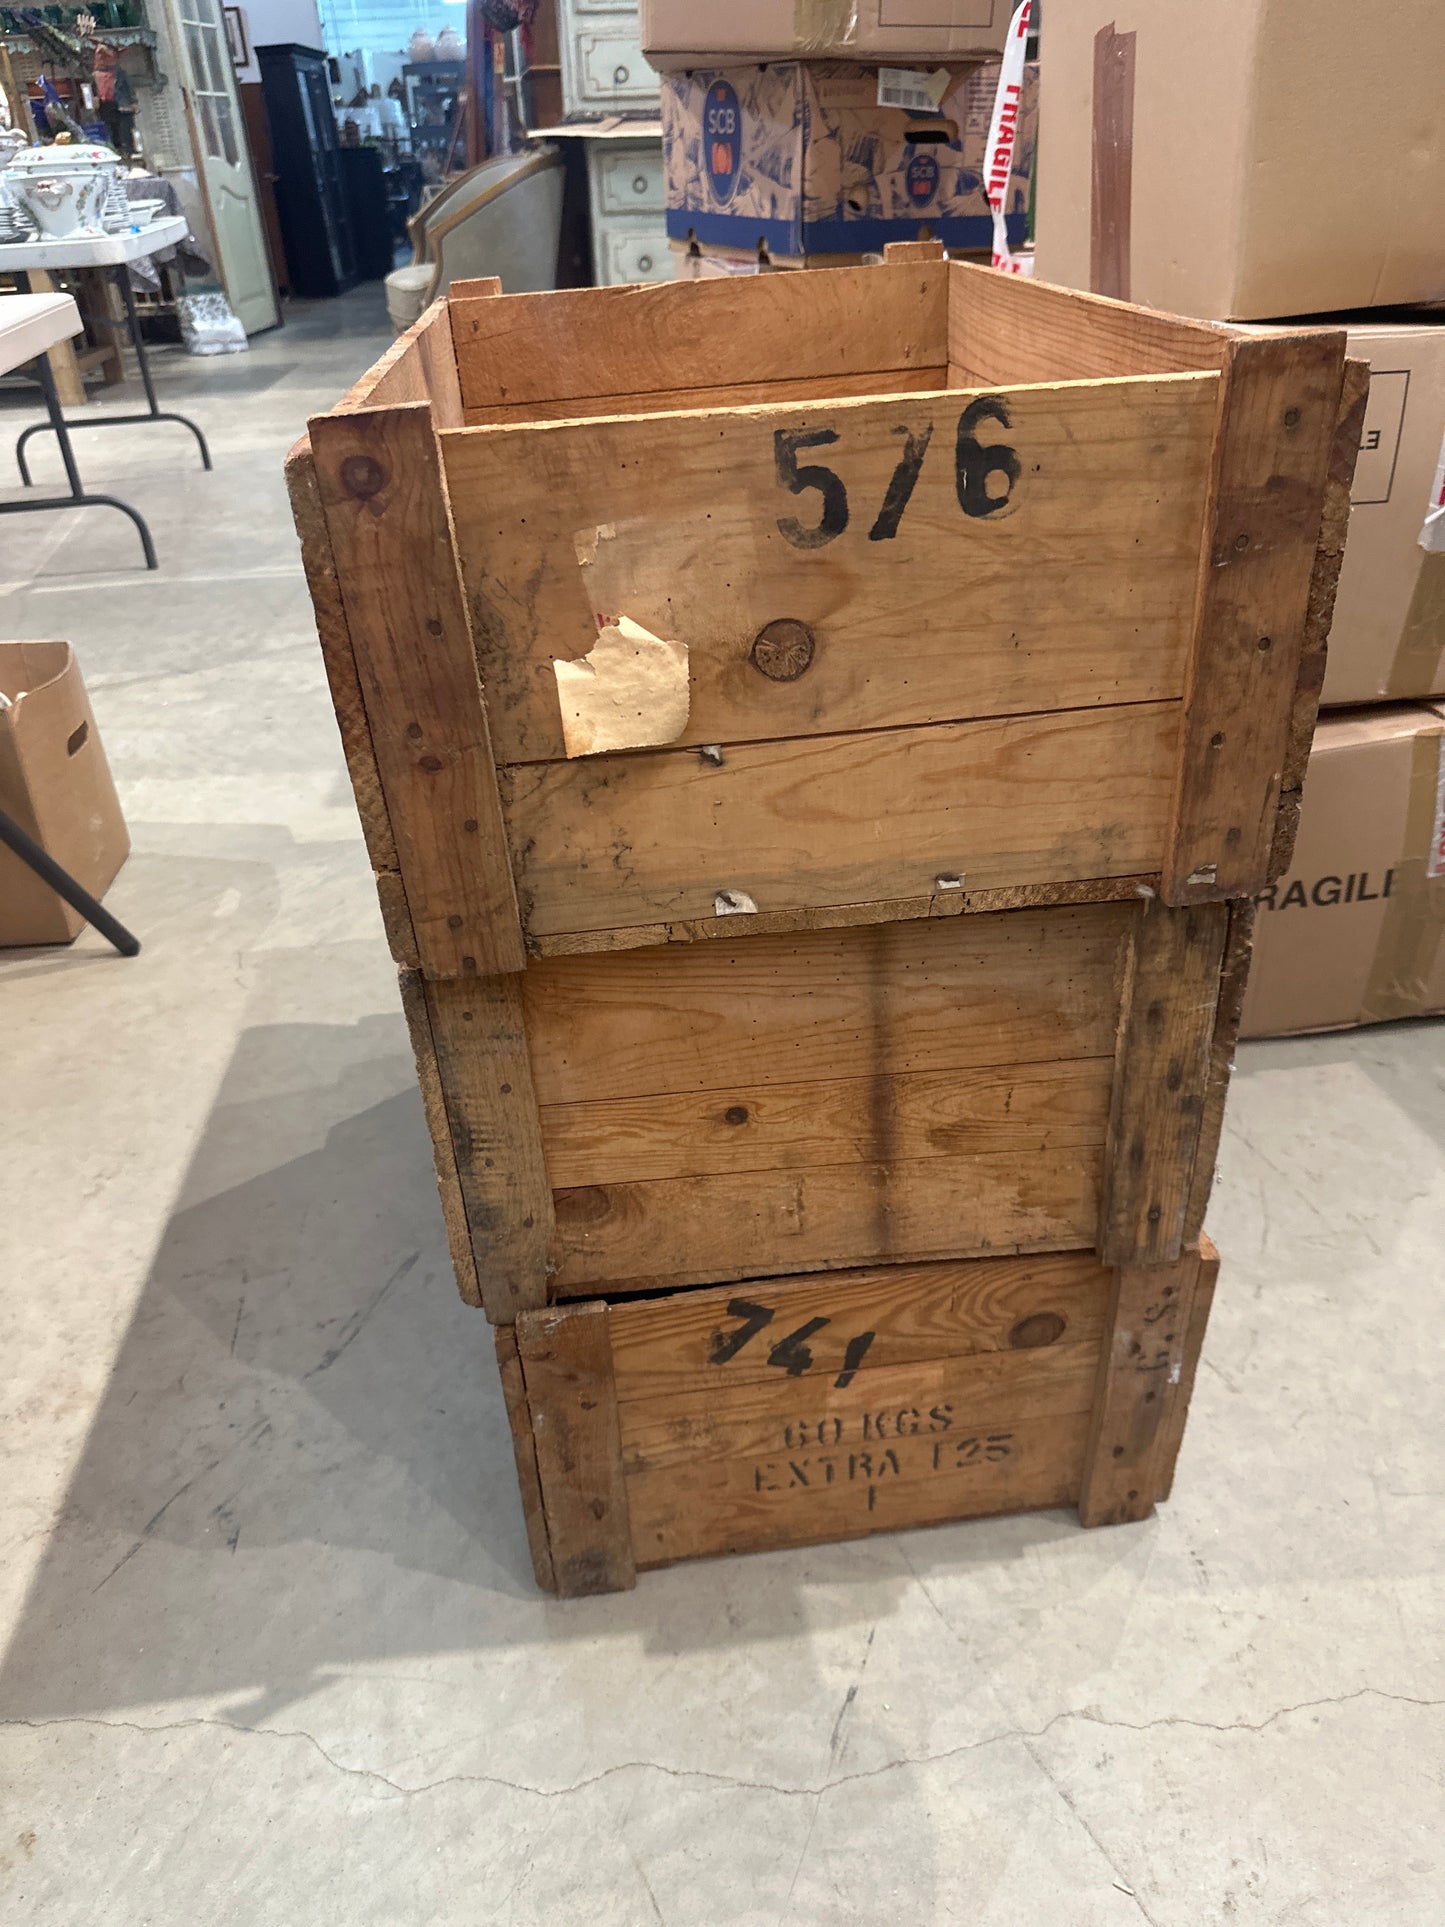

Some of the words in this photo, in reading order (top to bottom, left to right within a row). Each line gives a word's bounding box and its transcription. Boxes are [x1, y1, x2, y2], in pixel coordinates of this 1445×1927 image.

[708, 108, 736, 134] SCB
[774, 394, 1022, 550] 576
[1252, 868, 1395, 912] RAGIL
[708, 1298, 876, 1389] 741
[755, 1449, 899, 1492] EXTRA
